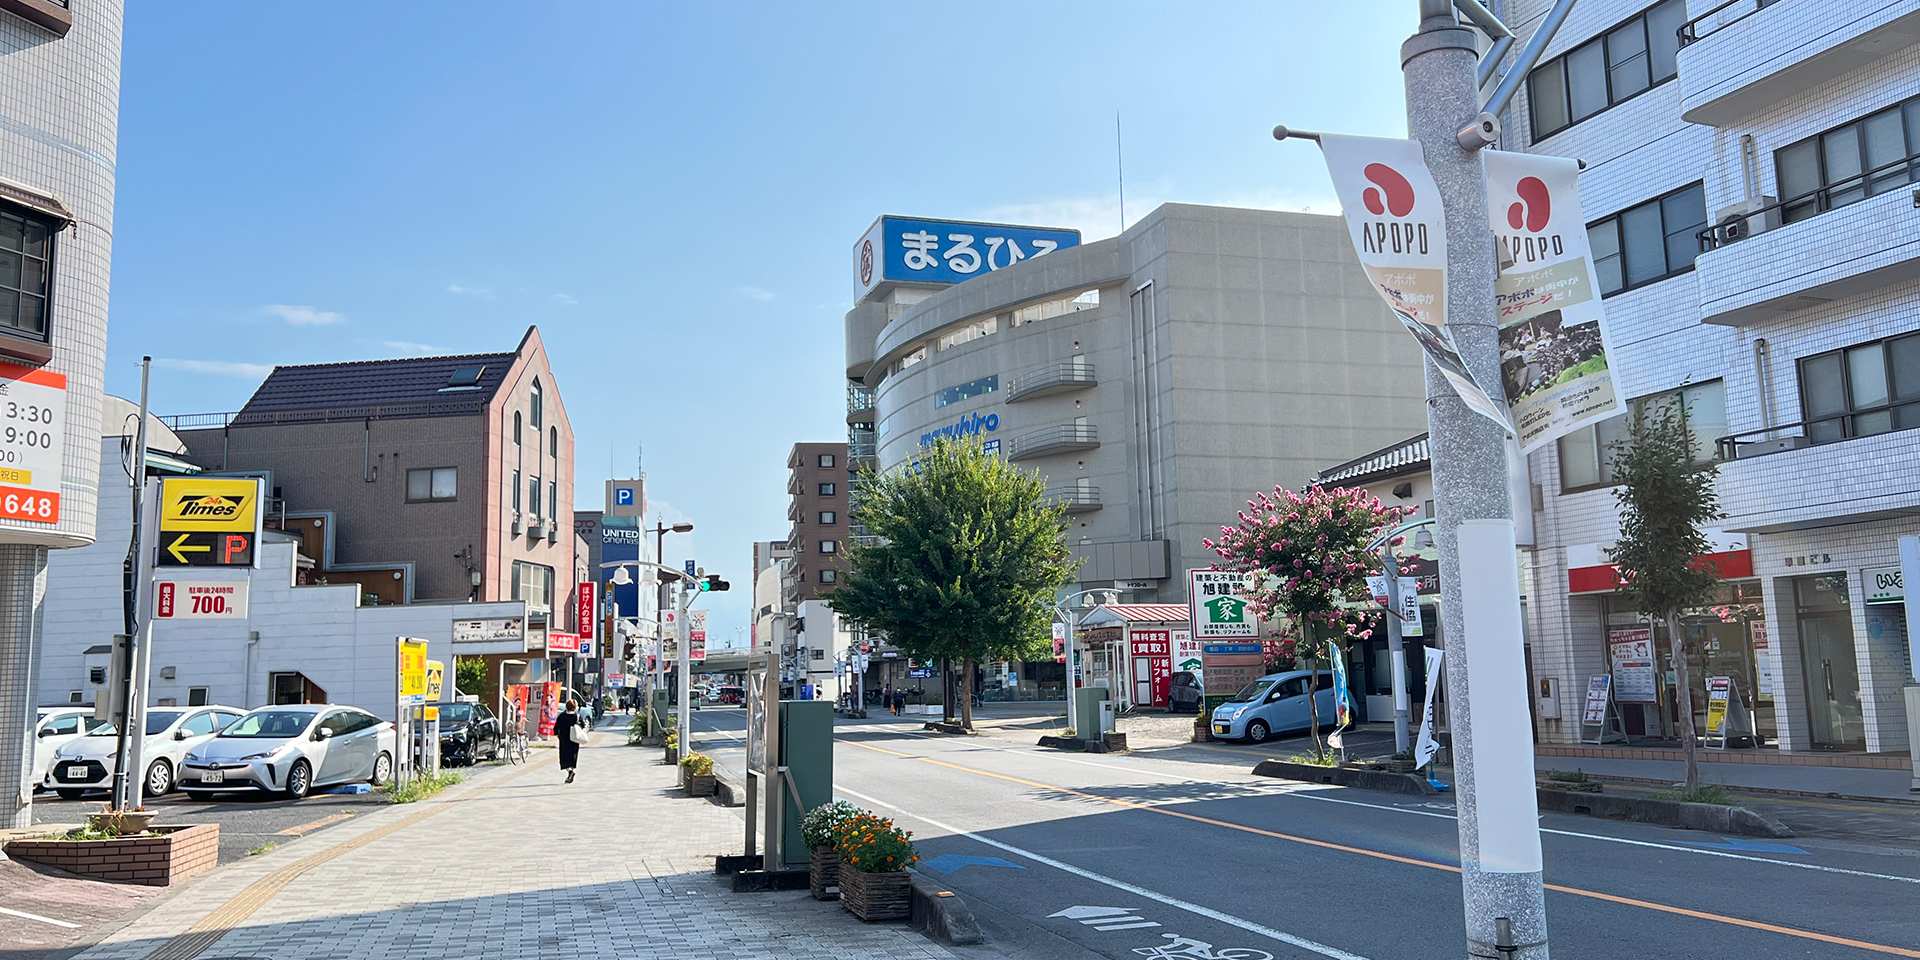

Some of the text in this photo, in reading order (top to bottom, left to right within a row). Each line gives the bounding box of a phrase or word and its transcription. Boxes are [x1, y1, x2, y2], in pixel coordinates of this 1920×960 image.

[1364, 222, 1429, 255] APOPO
[1513, 267, 1554, 287] アポポ
[1495, 276, 1579, 305] アポポは街中が
[5, 426, 51, 449] 9:00
[920, 412, 999, 448] maruhiro
[0, 494, 51, 518] 648
[177, 495, 245, 516] Times
[619, 490, 631, 504] P
[602, 529, 638, 539] UNITED
[602, 536, 638, 546] cinemas
[225, 535, 247, 564] P
[582, 587, 591, 633] ほけんの窓口
[1218, 598, 1237, 620] 家
[1132, 633, 1166, 641] 無料査定
[1180, 642, 1201, 650] 旭建
[1161, 659, 1169, 677] 新築
[1153, 659, 1162, 702] リフォーム
